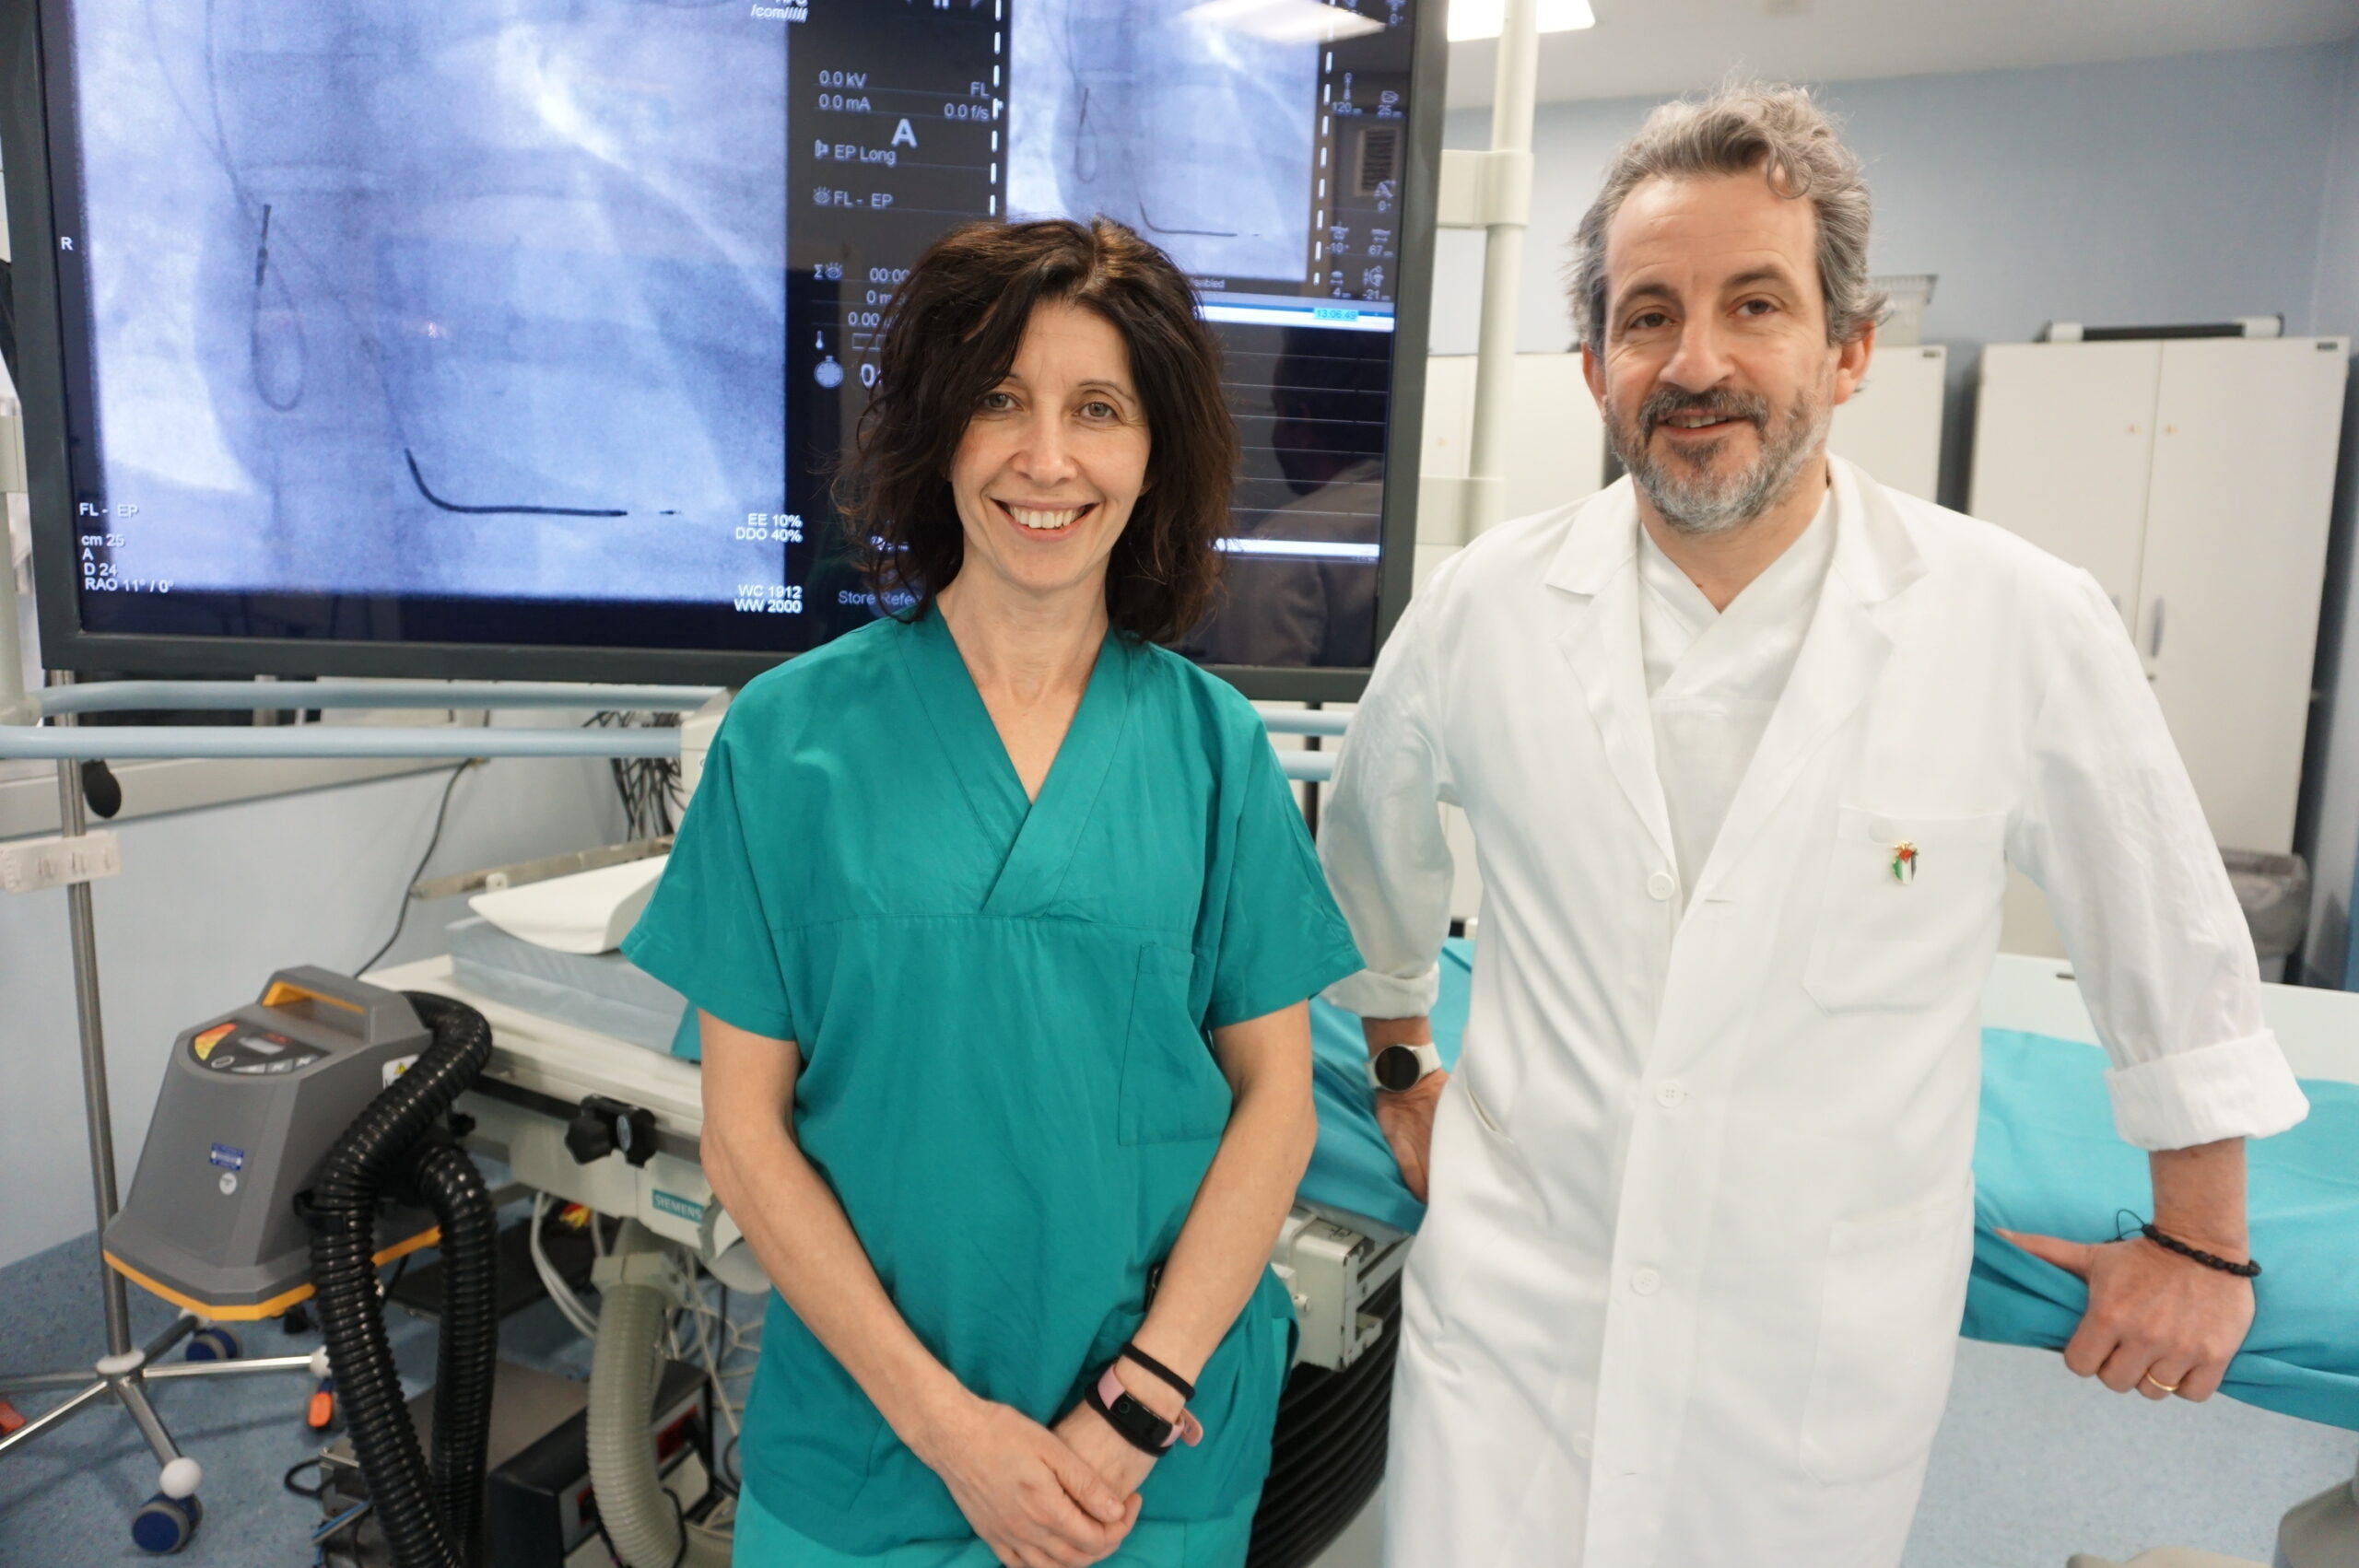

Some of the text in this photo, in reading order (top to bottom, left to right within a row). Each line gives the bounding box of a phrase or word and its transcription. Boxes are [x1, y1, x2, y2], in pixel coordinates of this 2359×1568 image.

[819, 70, 867, 88] 0.0 kV
[970, 82, 990, 98] FL
[819, 93, 871, 111] 0.0 mA
[944, 103, 990, 121] 0.0 f/s
[891, 118, 918, 148] A
[834, 145, 897, 167] EP Long
[833, 191, 852, 205] FL
[871, 193, 894, 208] EP
[61, 236, 74, 250] R
[79, 502, 99, 516] FL
[117, 504, 138, 518] EP
[748, 513, 803, 528] EE 10%
[81, 533, 125, 547] cm 25
[735, 527, 803, 543] DDO 40%
[82, 547, 94, 561] A
[84, 562, 118, 577] D 24
[85, 577, 118, 591] RAO
[738, 585, 803, 599] WC 1912
[838, 591, 875, 606] Store
[734, 599, 803, 614] WW 2000
